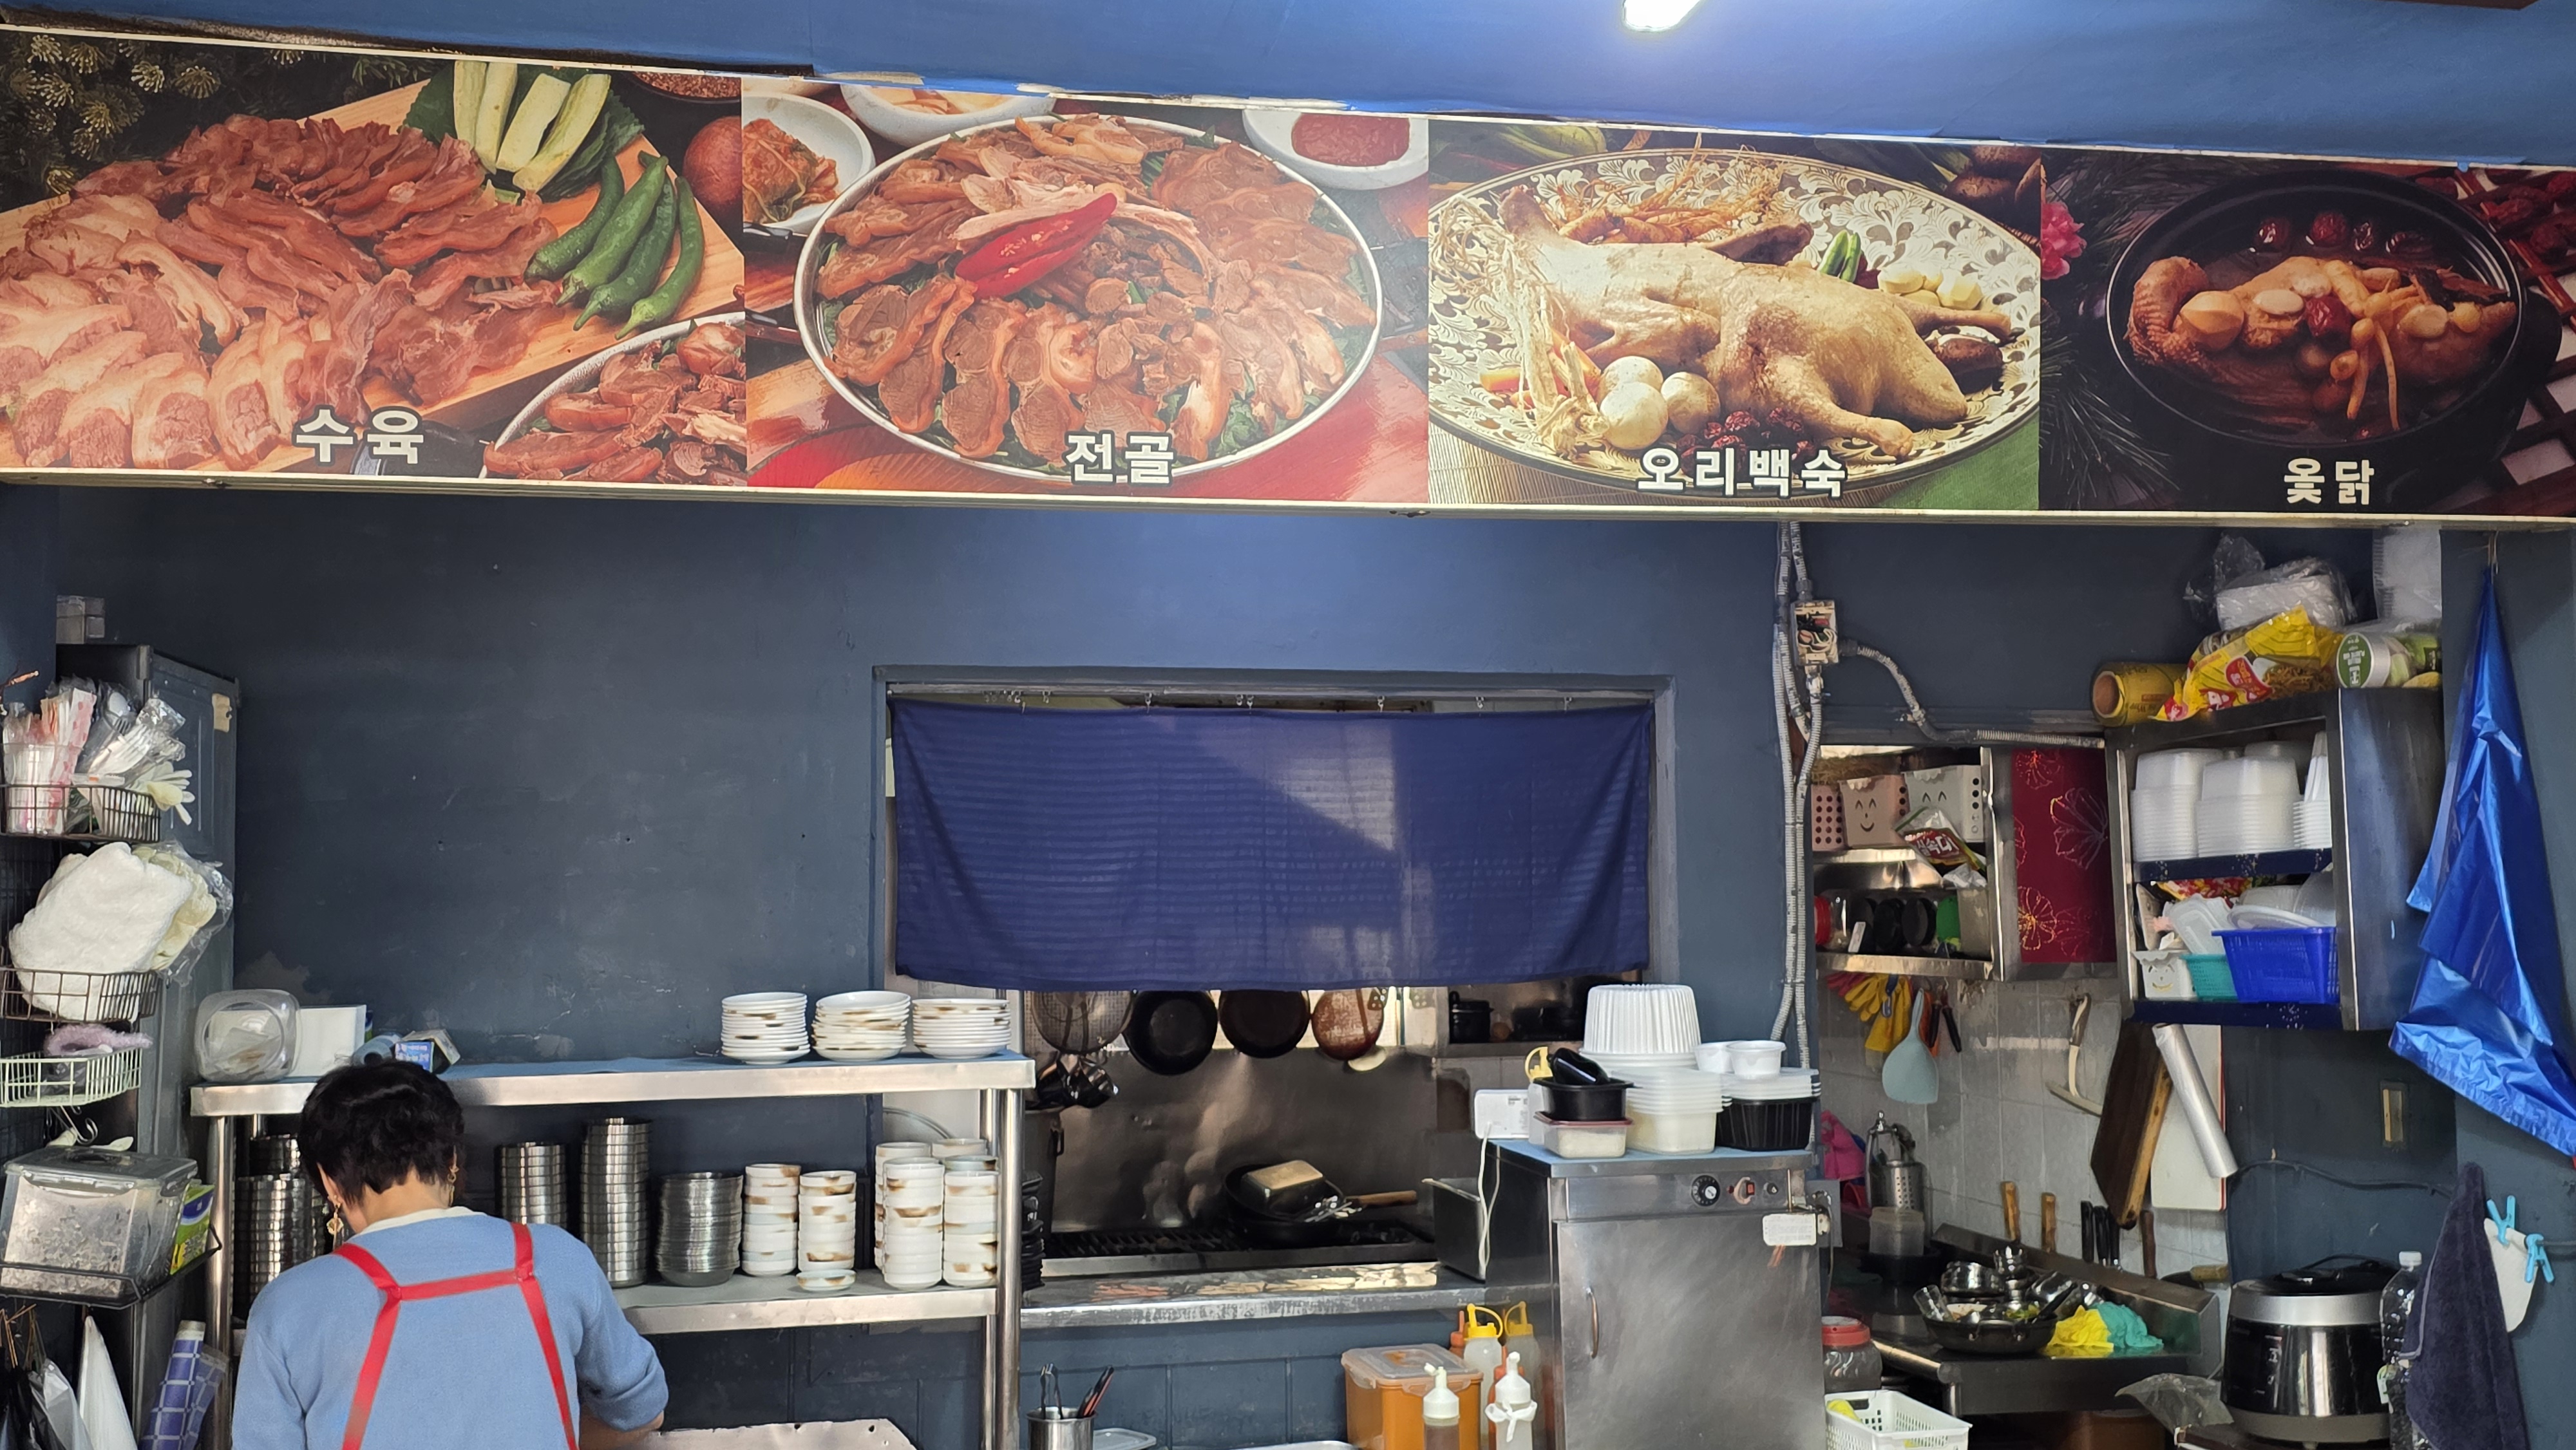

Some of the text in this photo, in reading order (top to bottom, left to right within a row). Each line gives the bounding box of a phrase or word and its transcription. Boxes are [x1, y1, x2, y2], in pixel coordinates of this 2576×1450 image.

[296, 408, 424, 465] 수육
[1065, 433, 1174, 484] 전골
[1638, 447, 1846, 498] 오리백숙
[2283, 457, 2375, 505] 옻닭
